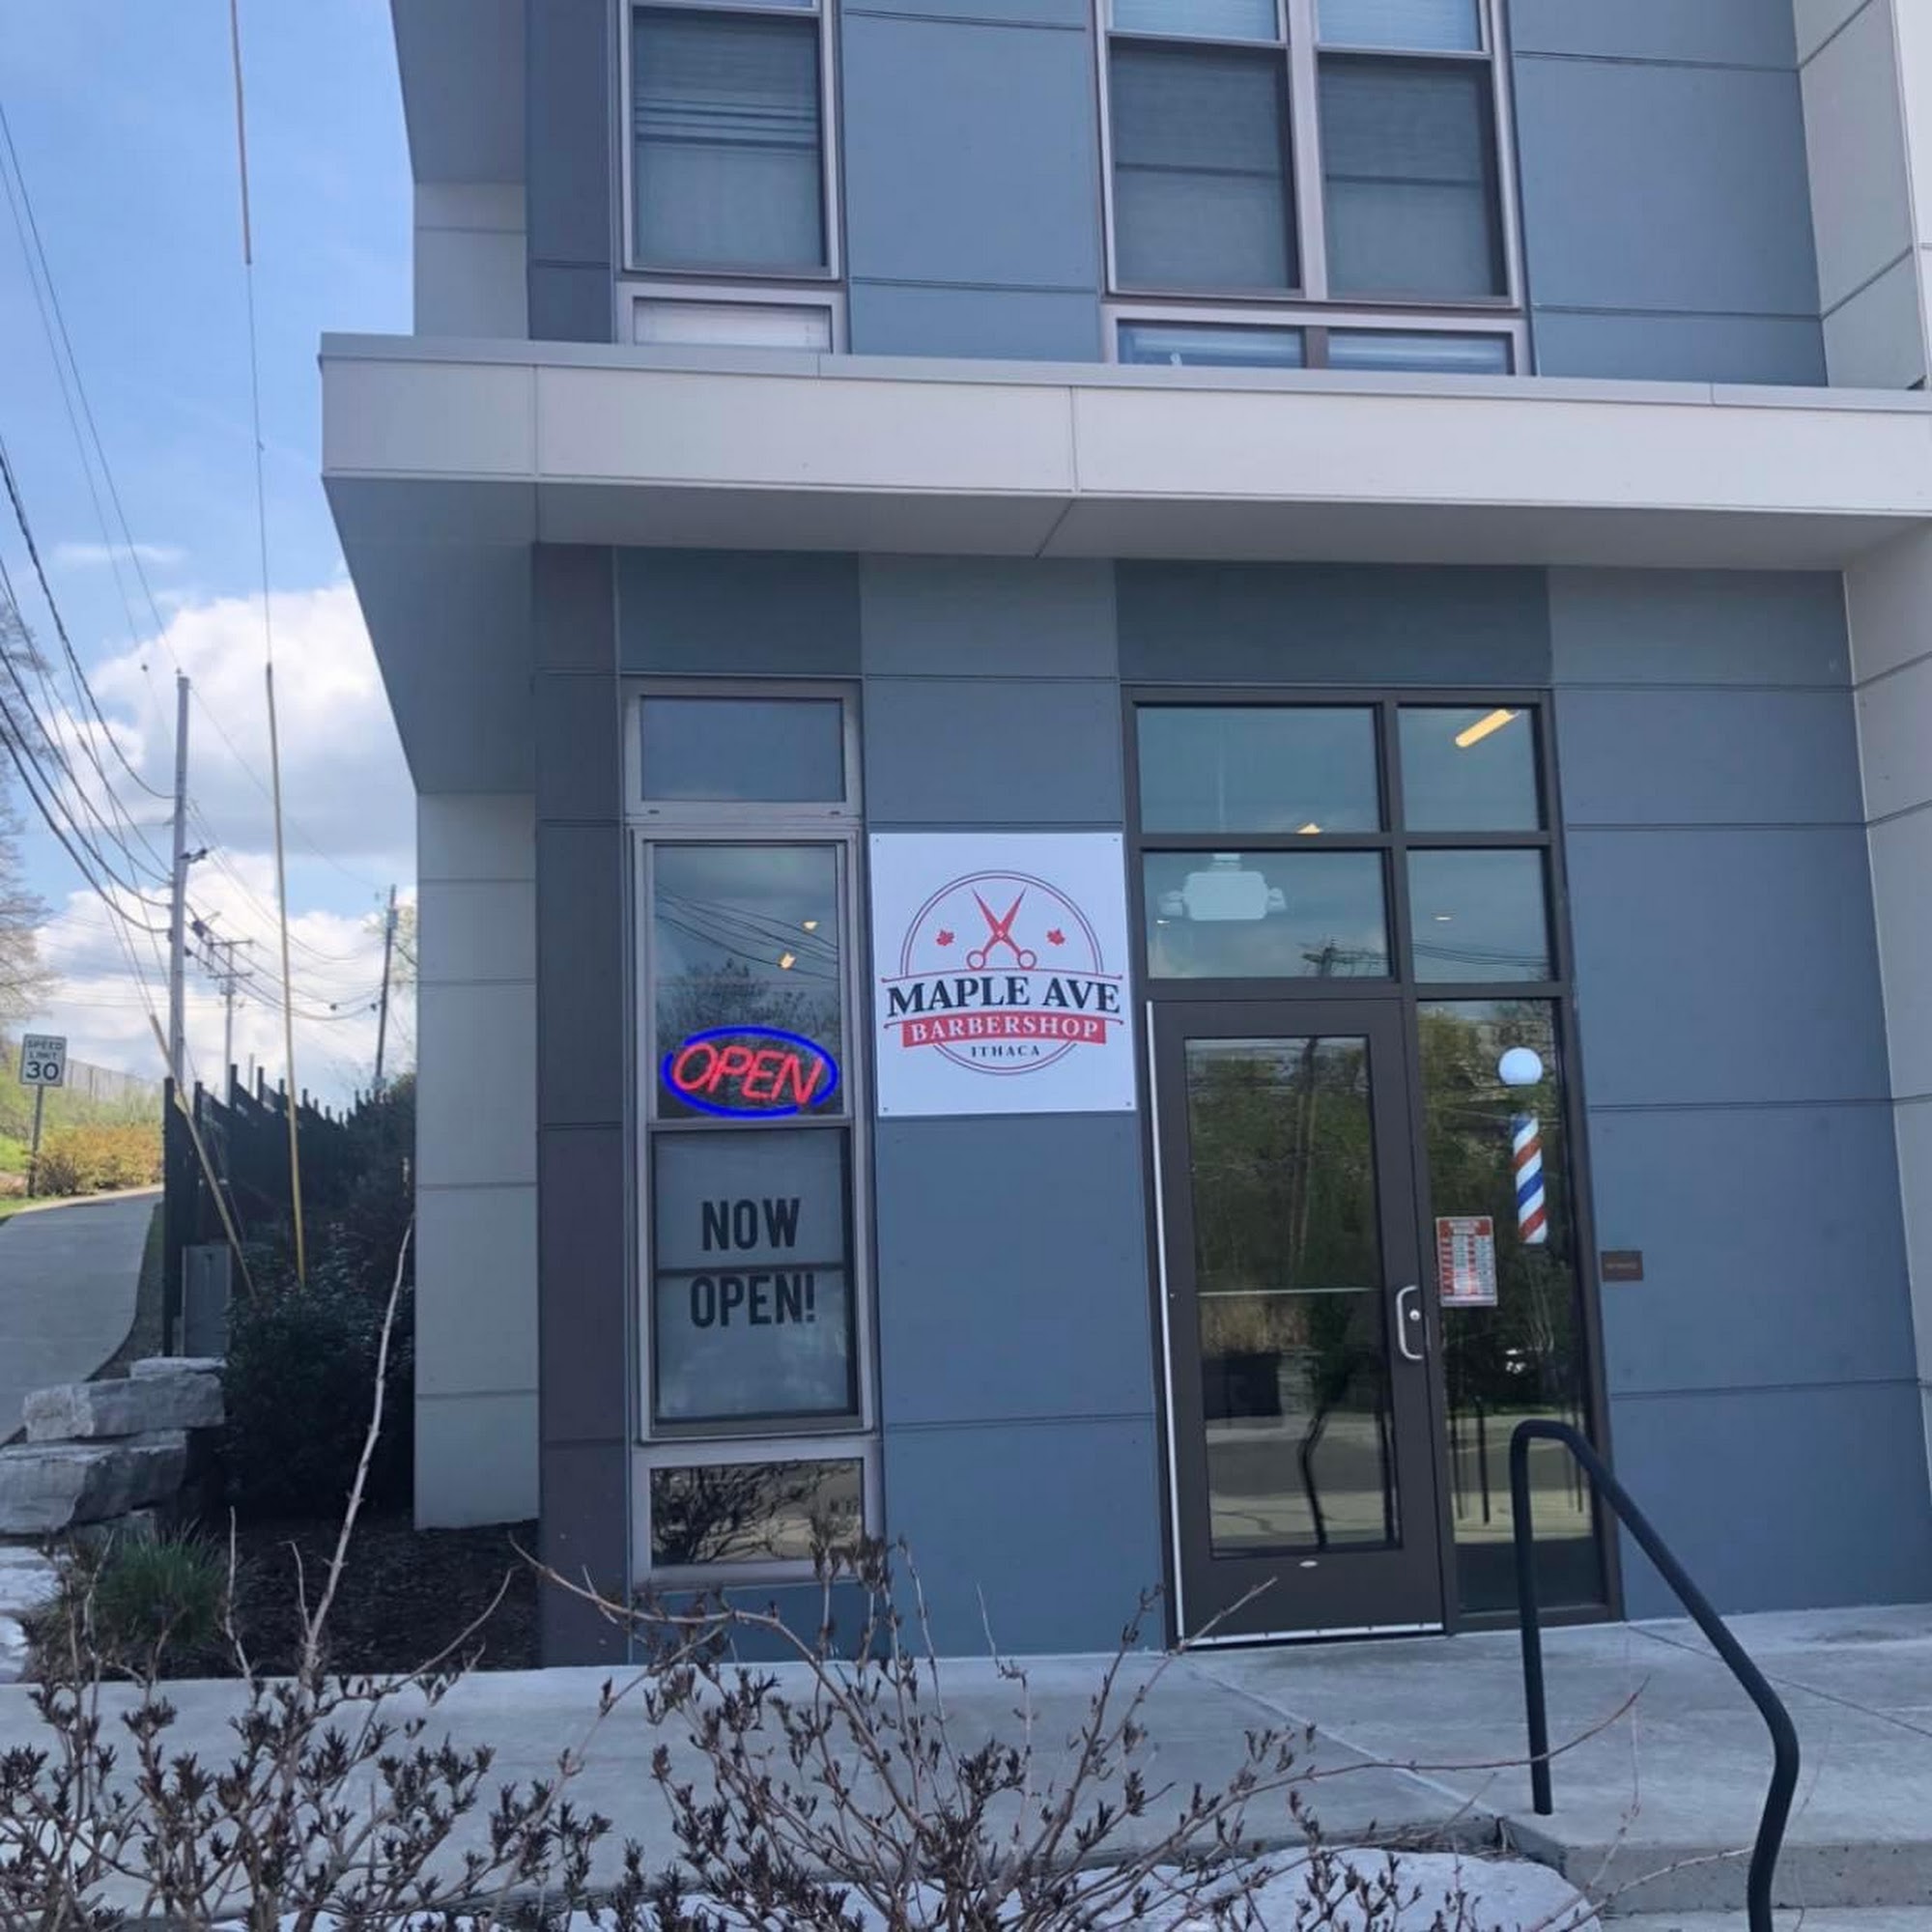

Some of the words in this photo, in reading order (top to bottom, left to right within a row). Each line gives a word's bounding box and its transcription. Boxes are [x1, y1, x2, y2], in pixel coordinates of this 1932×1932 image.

[887, 976, 1030, 1017] MAPLE
[1041, 977, 1121, 1013] AVE
[911, 1016, 1098, 1041] BARBERSHOP
[26, 1061, 59, 1080] 30
[971, 1044, 1040, 1058] ITHACA
[673, 1042, 824, 1104] OPEN
[702, 1198, 801, 1251] NOW
[691, 1273, 815, 1328] OPEN!
